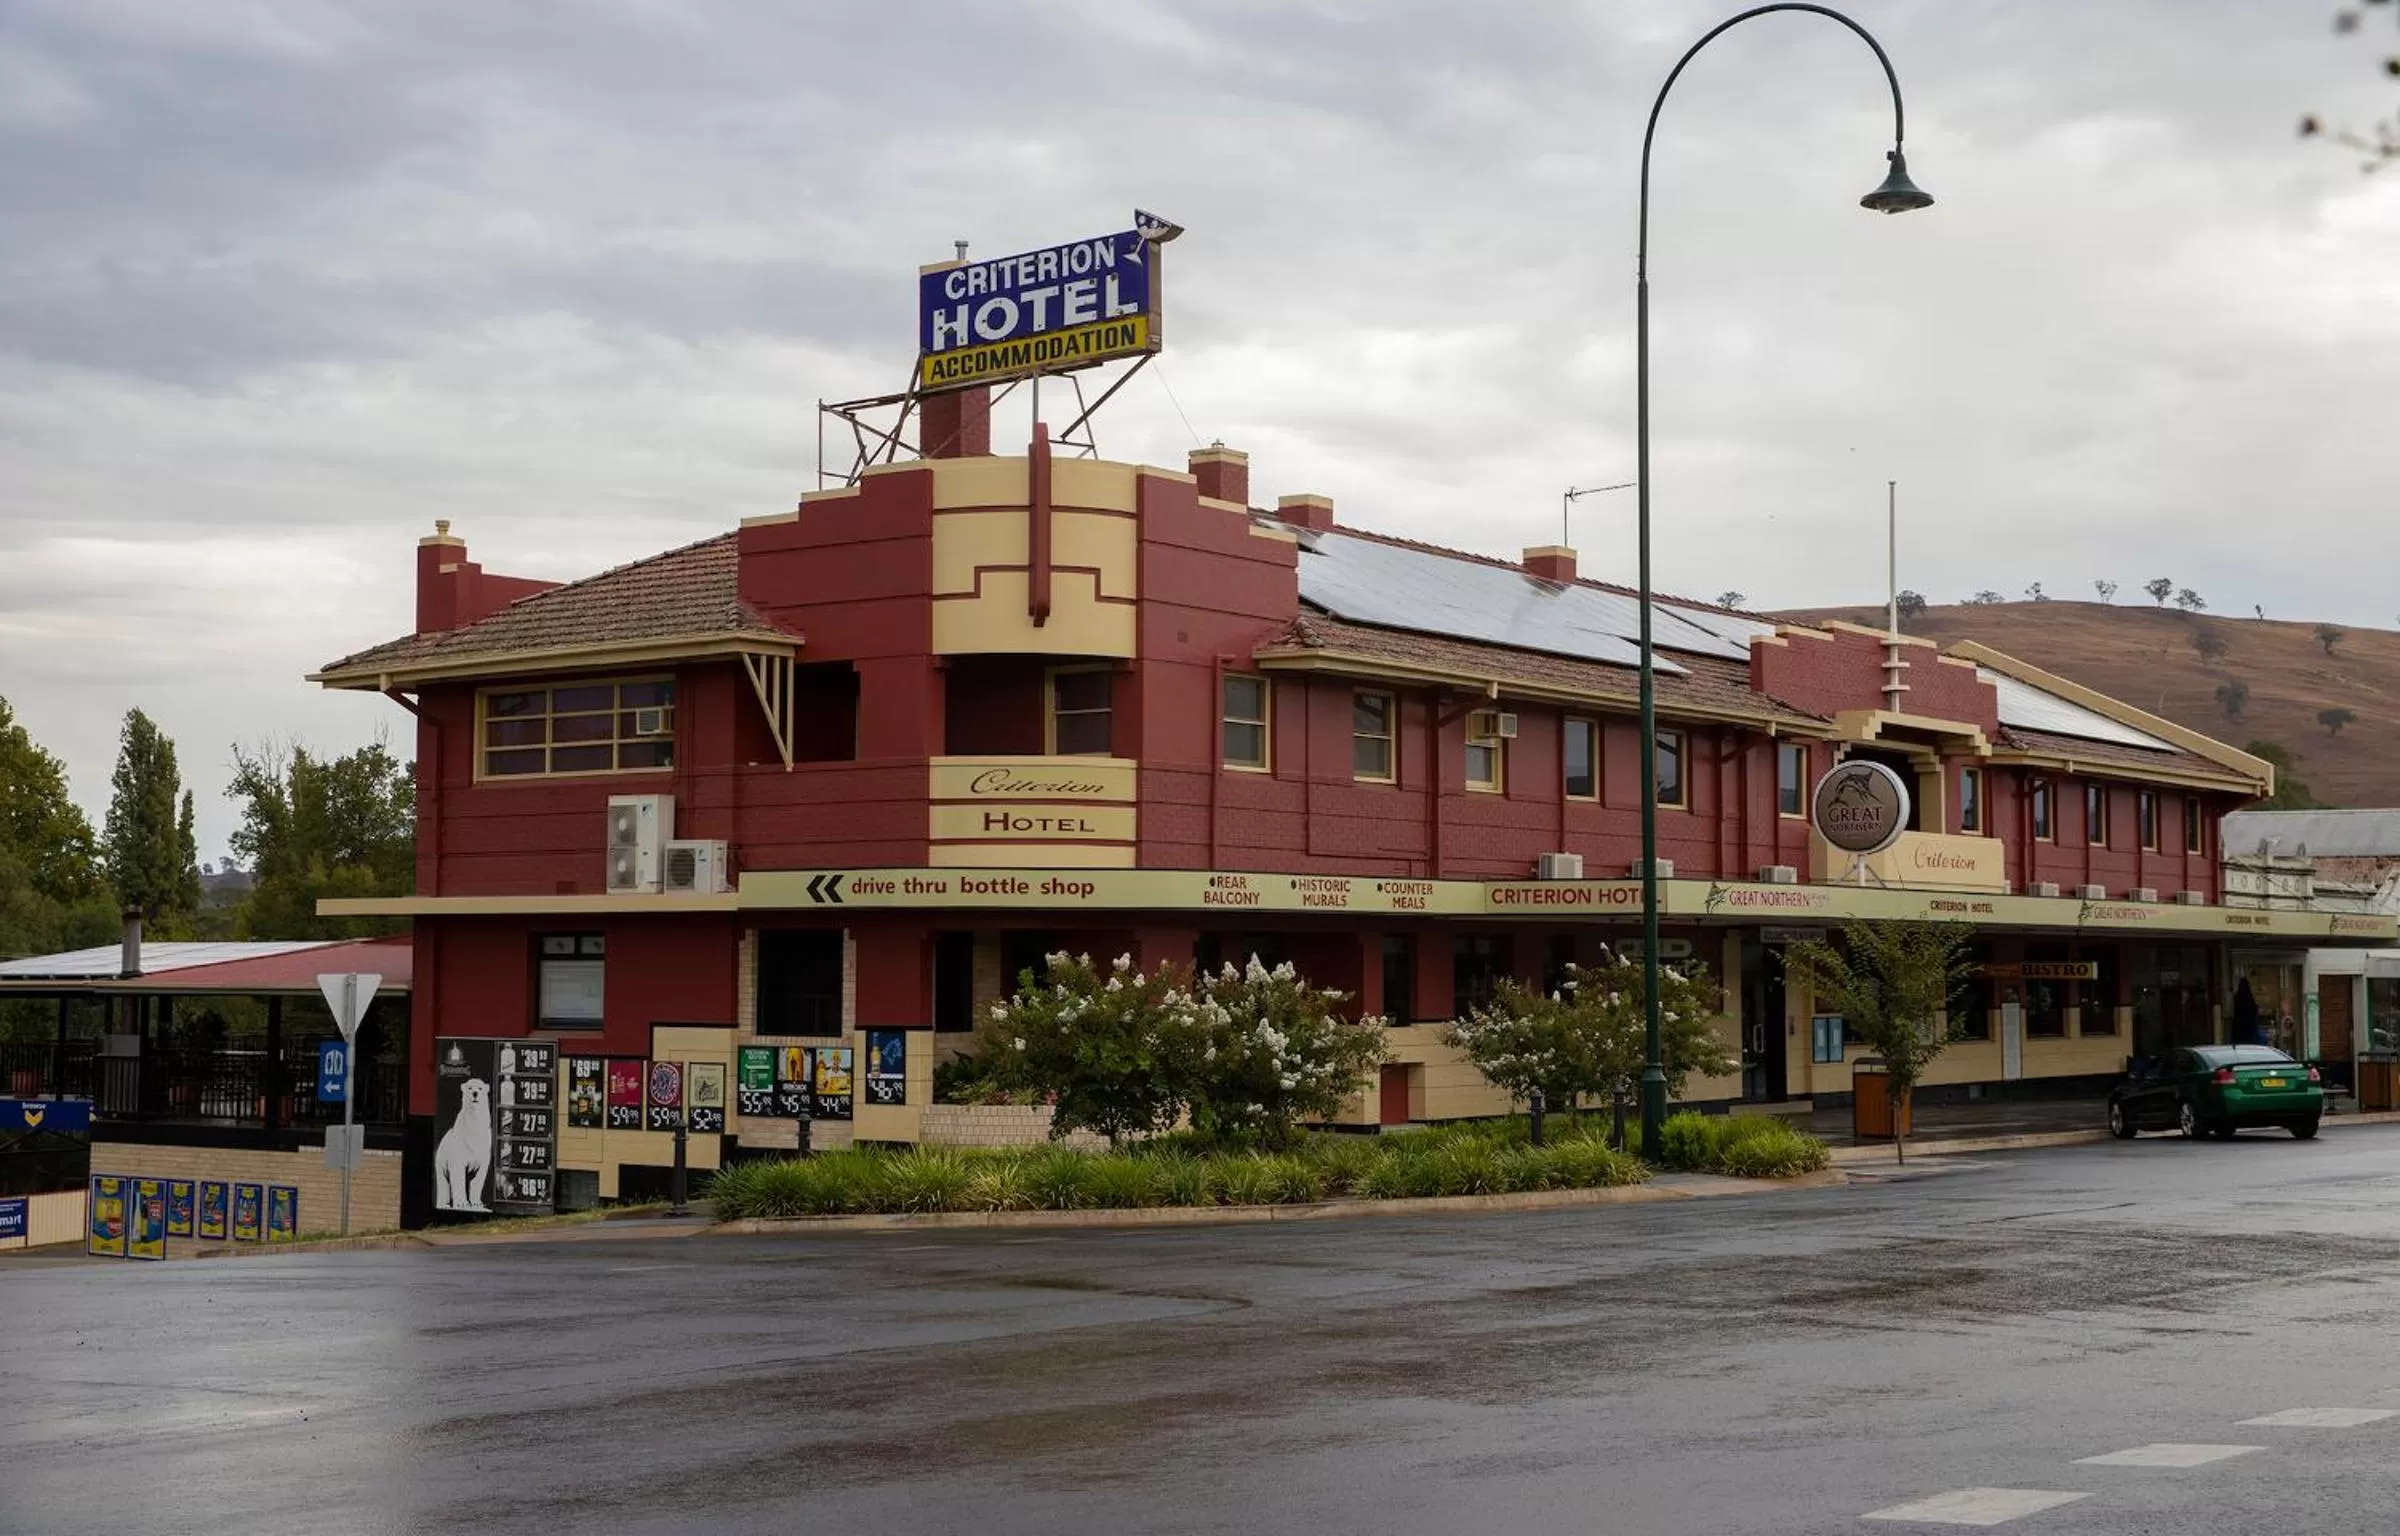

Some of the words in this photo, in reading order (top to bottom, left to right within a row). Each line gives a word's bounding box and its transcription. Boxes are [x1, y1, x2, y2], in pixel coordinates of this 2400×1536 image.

[945, 239, 1116, 300] CRITERION
[932, 273, 1138, 350] HOTEL
[931, 323, 1136, 382] ACCOMMODATION
[970, 768, 1104, 794] Criterion
[1828, 806, 1883, 822] GREAT
[983, 812, 1096, 833] HOTEL
[1914, 843, 1976, 871] Criterion
[851, 877, 896, 894] drive
[903, 876, 948, 894] thru
[960, 876, 1030, 894] bottle
[1040, 876, 1096, 898] shop
[1217, 876, 1247, 889] REAR
[1298, 879, 1351, 893] HISTORIC
[1383, 882, 1433, 895] COUNTER
[1203, 891, 1260, 905] BALCONY
[1303, 894, 1348, 907] MURALS
[1392, 896, 1425, 909] MEALS
[1491, 888, 1592, 905] CRITERION
[1600, 888, 1662, 905] HOT
[1730, 889, 1759, 906] GREAT
[1760, 891, 1811, 907] NORTHERN
[1930, 900, 1969, 913] CRITERION
[1971, 902, 1994, 914] HOTEL
[2021, 962, 2089, 978] BISTRO
